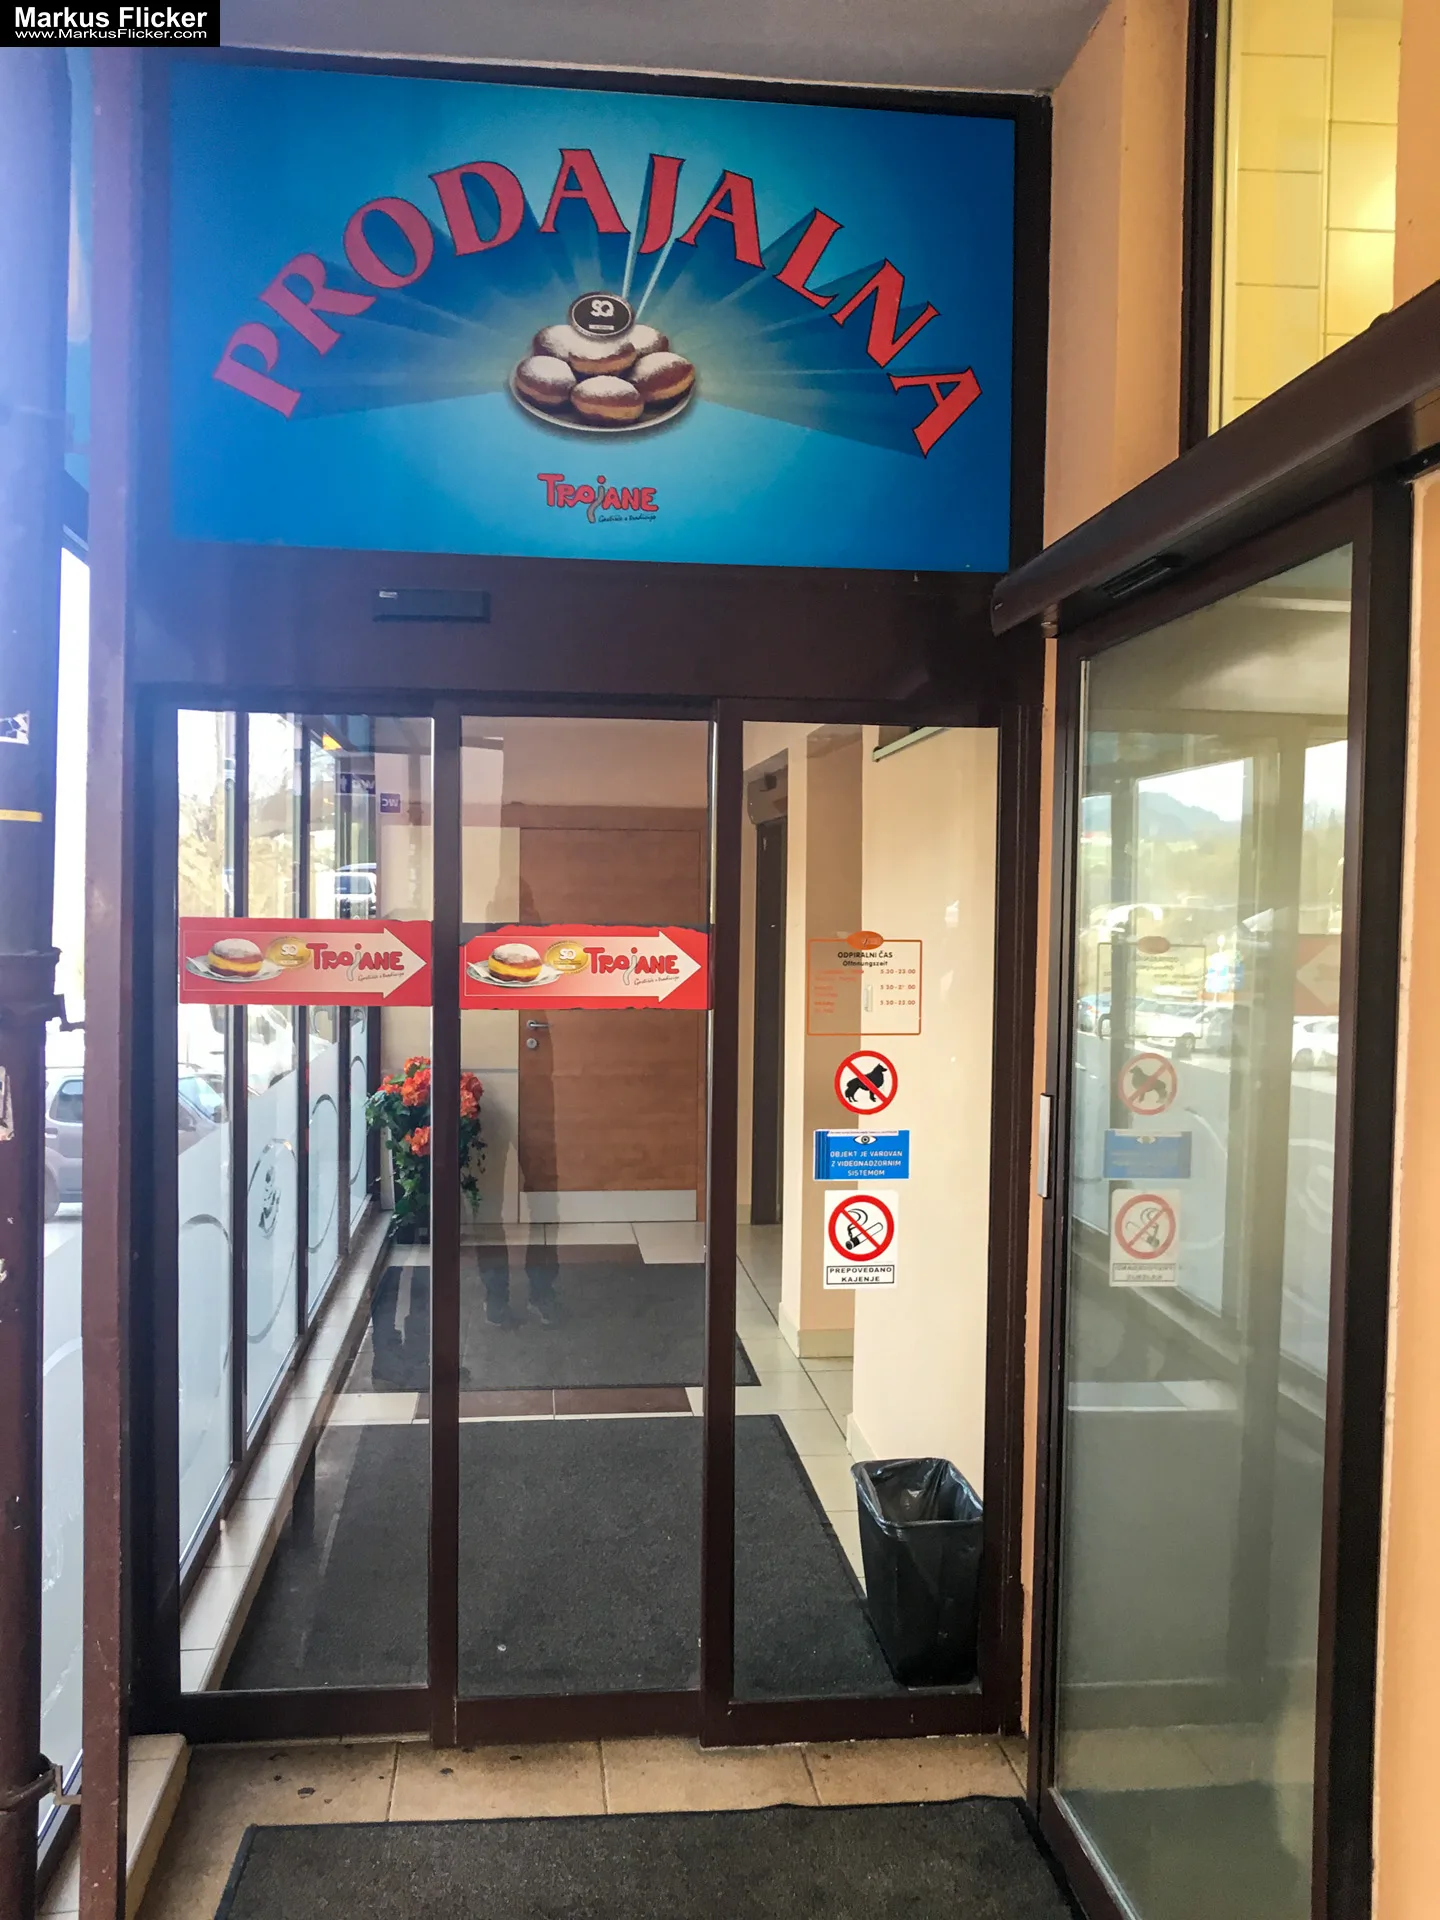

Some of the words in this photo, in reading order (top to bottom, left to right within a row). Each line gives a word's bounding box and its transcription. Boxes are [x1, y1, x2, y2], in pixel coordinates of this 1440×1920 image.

[213, 148, 982, 457] PRODAJALNA
[590, 299, 615, 317] SQ
[879, 950, 893, 958] ČAS
